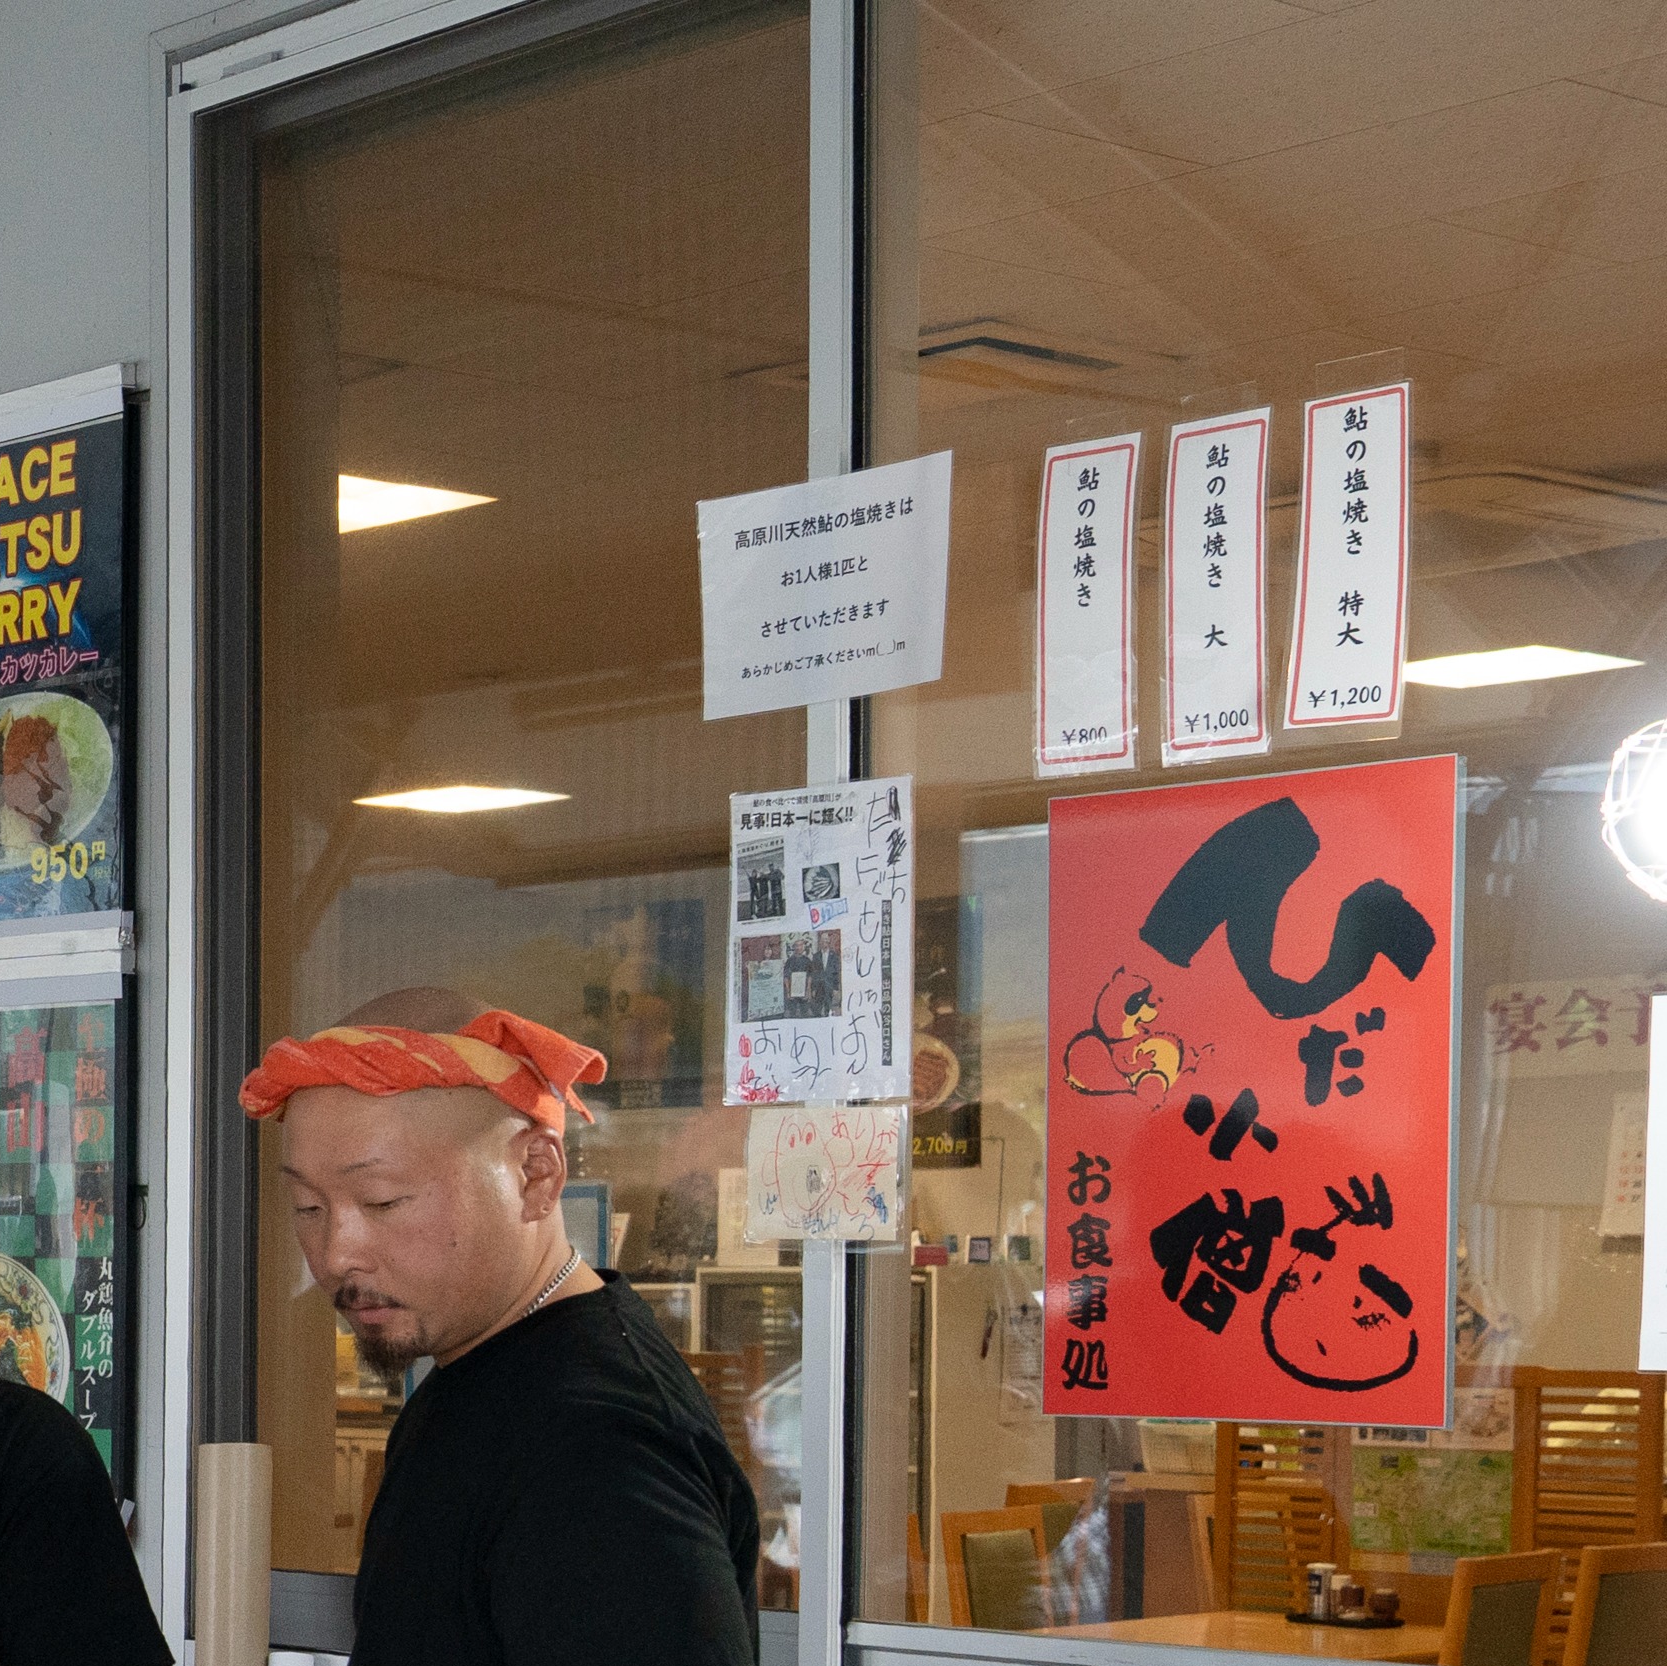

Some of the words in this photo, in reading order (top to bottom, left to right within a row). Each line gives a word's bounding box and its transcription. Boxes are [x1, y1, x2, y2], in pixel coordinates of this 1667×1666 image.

[1342, 405, 1370, 555] 鮎の塩焼き
[734, 496, 914, 550] 高原川天然鮎の塩焼きは
[1073, 466, 1100, 607] 鮎の塩焼き
[1203, 443, 1230, 588] 鮎の塩焼き
[780, 556, 869, 587] お1人様1匹と
[761, 598, 889, 638] させていただきます
[1204, 624, 1228, 648] 大
[1335, 590, 1365, 647] 特大
[1185, 708, 1249, 733] ¥1,000
[1308, 685, 1383, 711] ¥1,200
[1062, 725, 1108, 746] ¥800
[1059, 1149, 1112, 1392] お食事処
[79, 1290, 99, 1431] ダブルスープ
